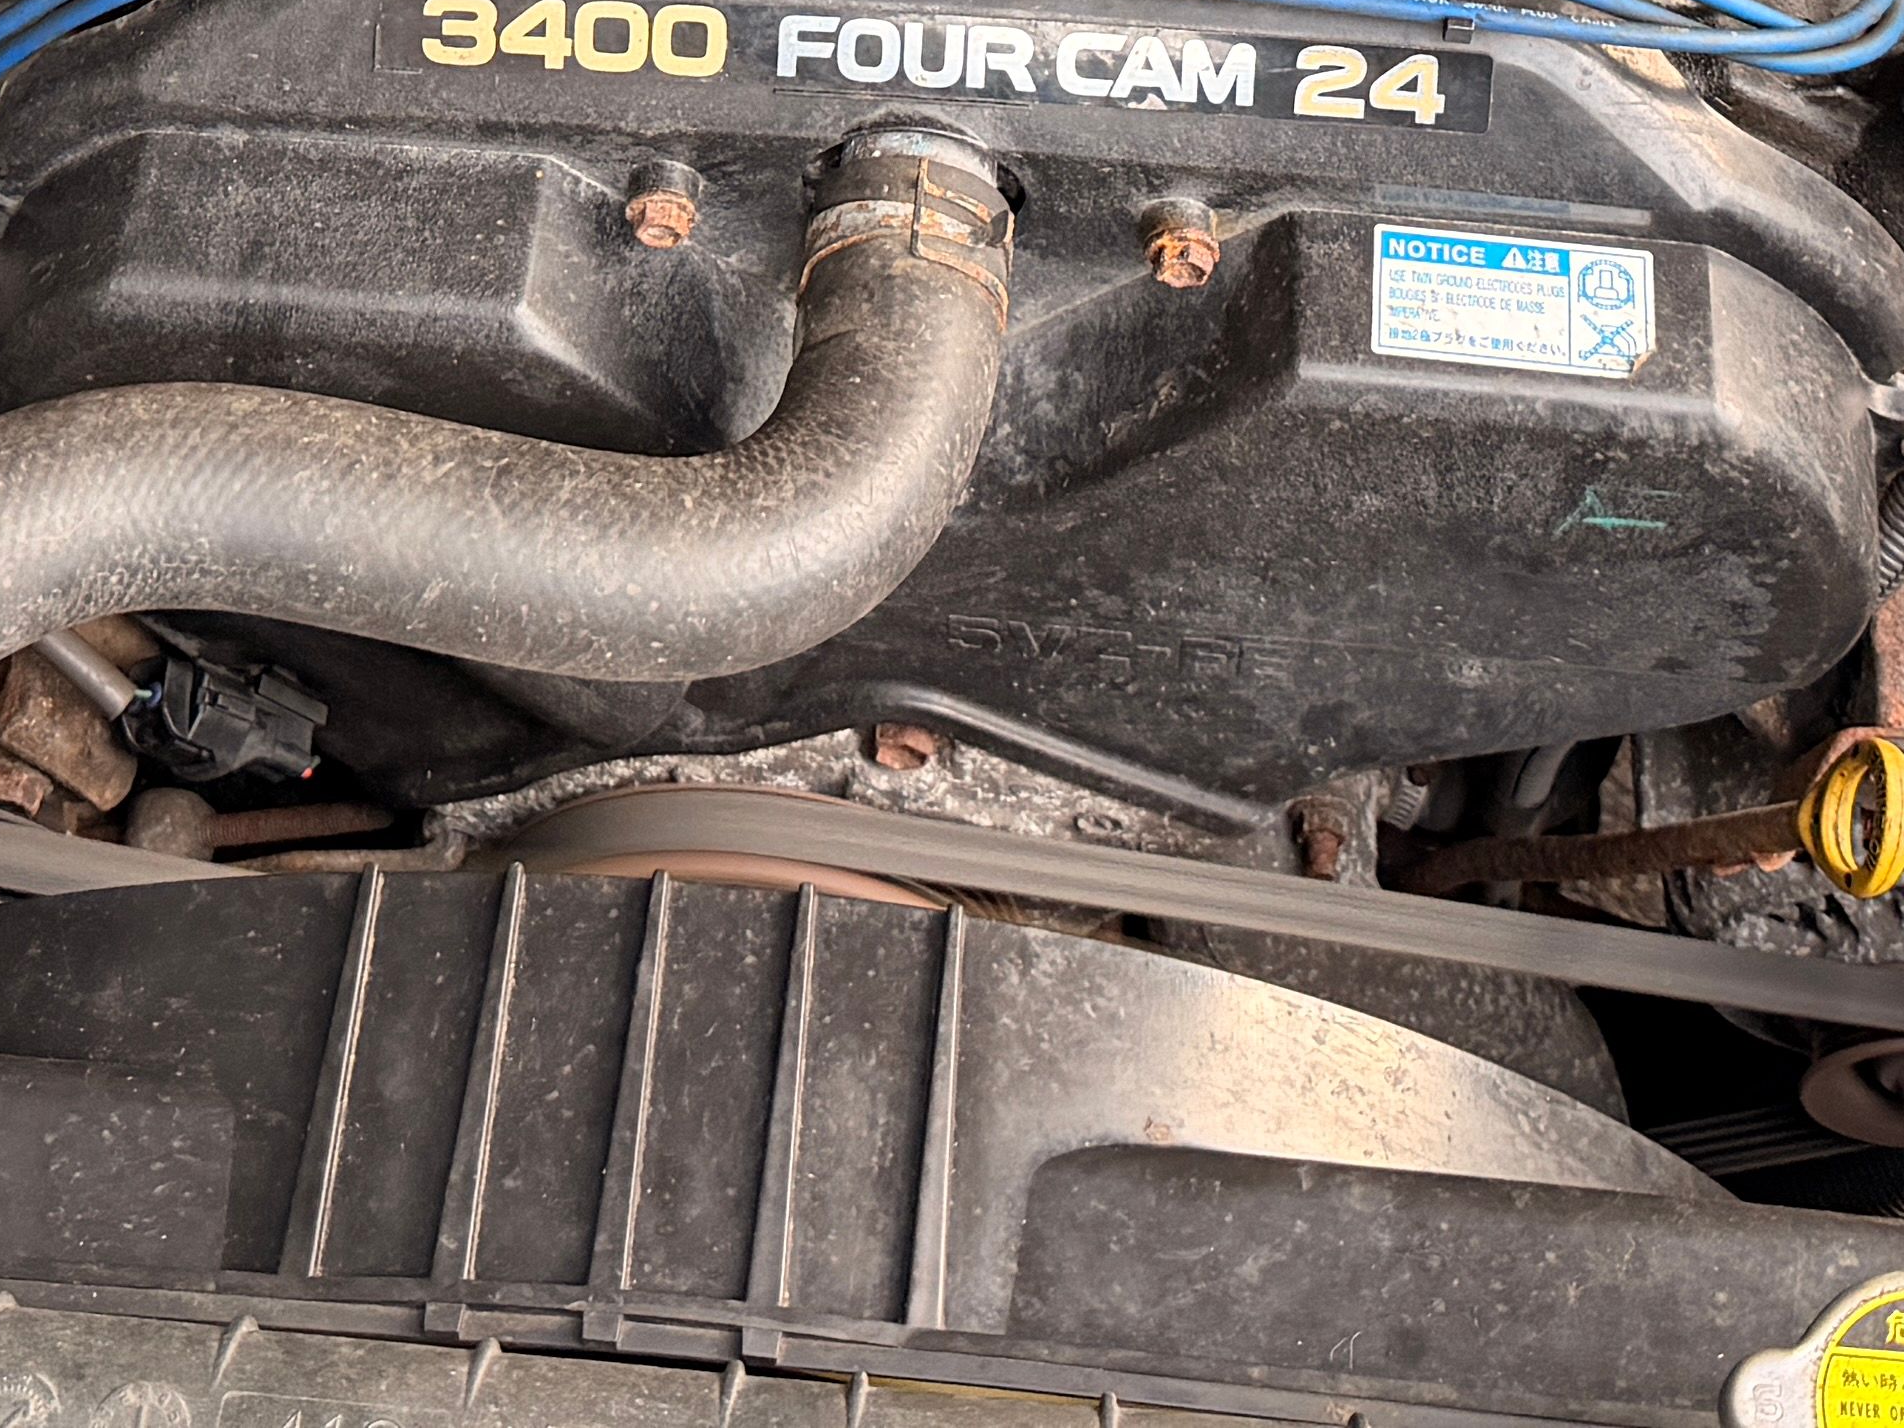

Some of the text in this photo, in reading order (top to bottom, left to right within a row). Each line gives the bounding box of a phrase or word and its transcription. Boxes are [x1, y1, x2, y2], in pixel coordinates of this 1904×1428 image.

[777, 14, 1036, 97] FOUR
[1057, 29, 1256, 108] CAM
[1293, 43, 1446, 125] 24
[1388, 237, 1487, 266] NOTICE
[1527, 248, 1560, 273] 注意
[1389, 268, 1566, 298] USE TWIN GROUND ELECTRODES PLUGS
[1500, 298, 1512, 311] DE
[1516, 299, 1545, 315] MASSE
[1839, 1400, 1881, 1420] NEVER
